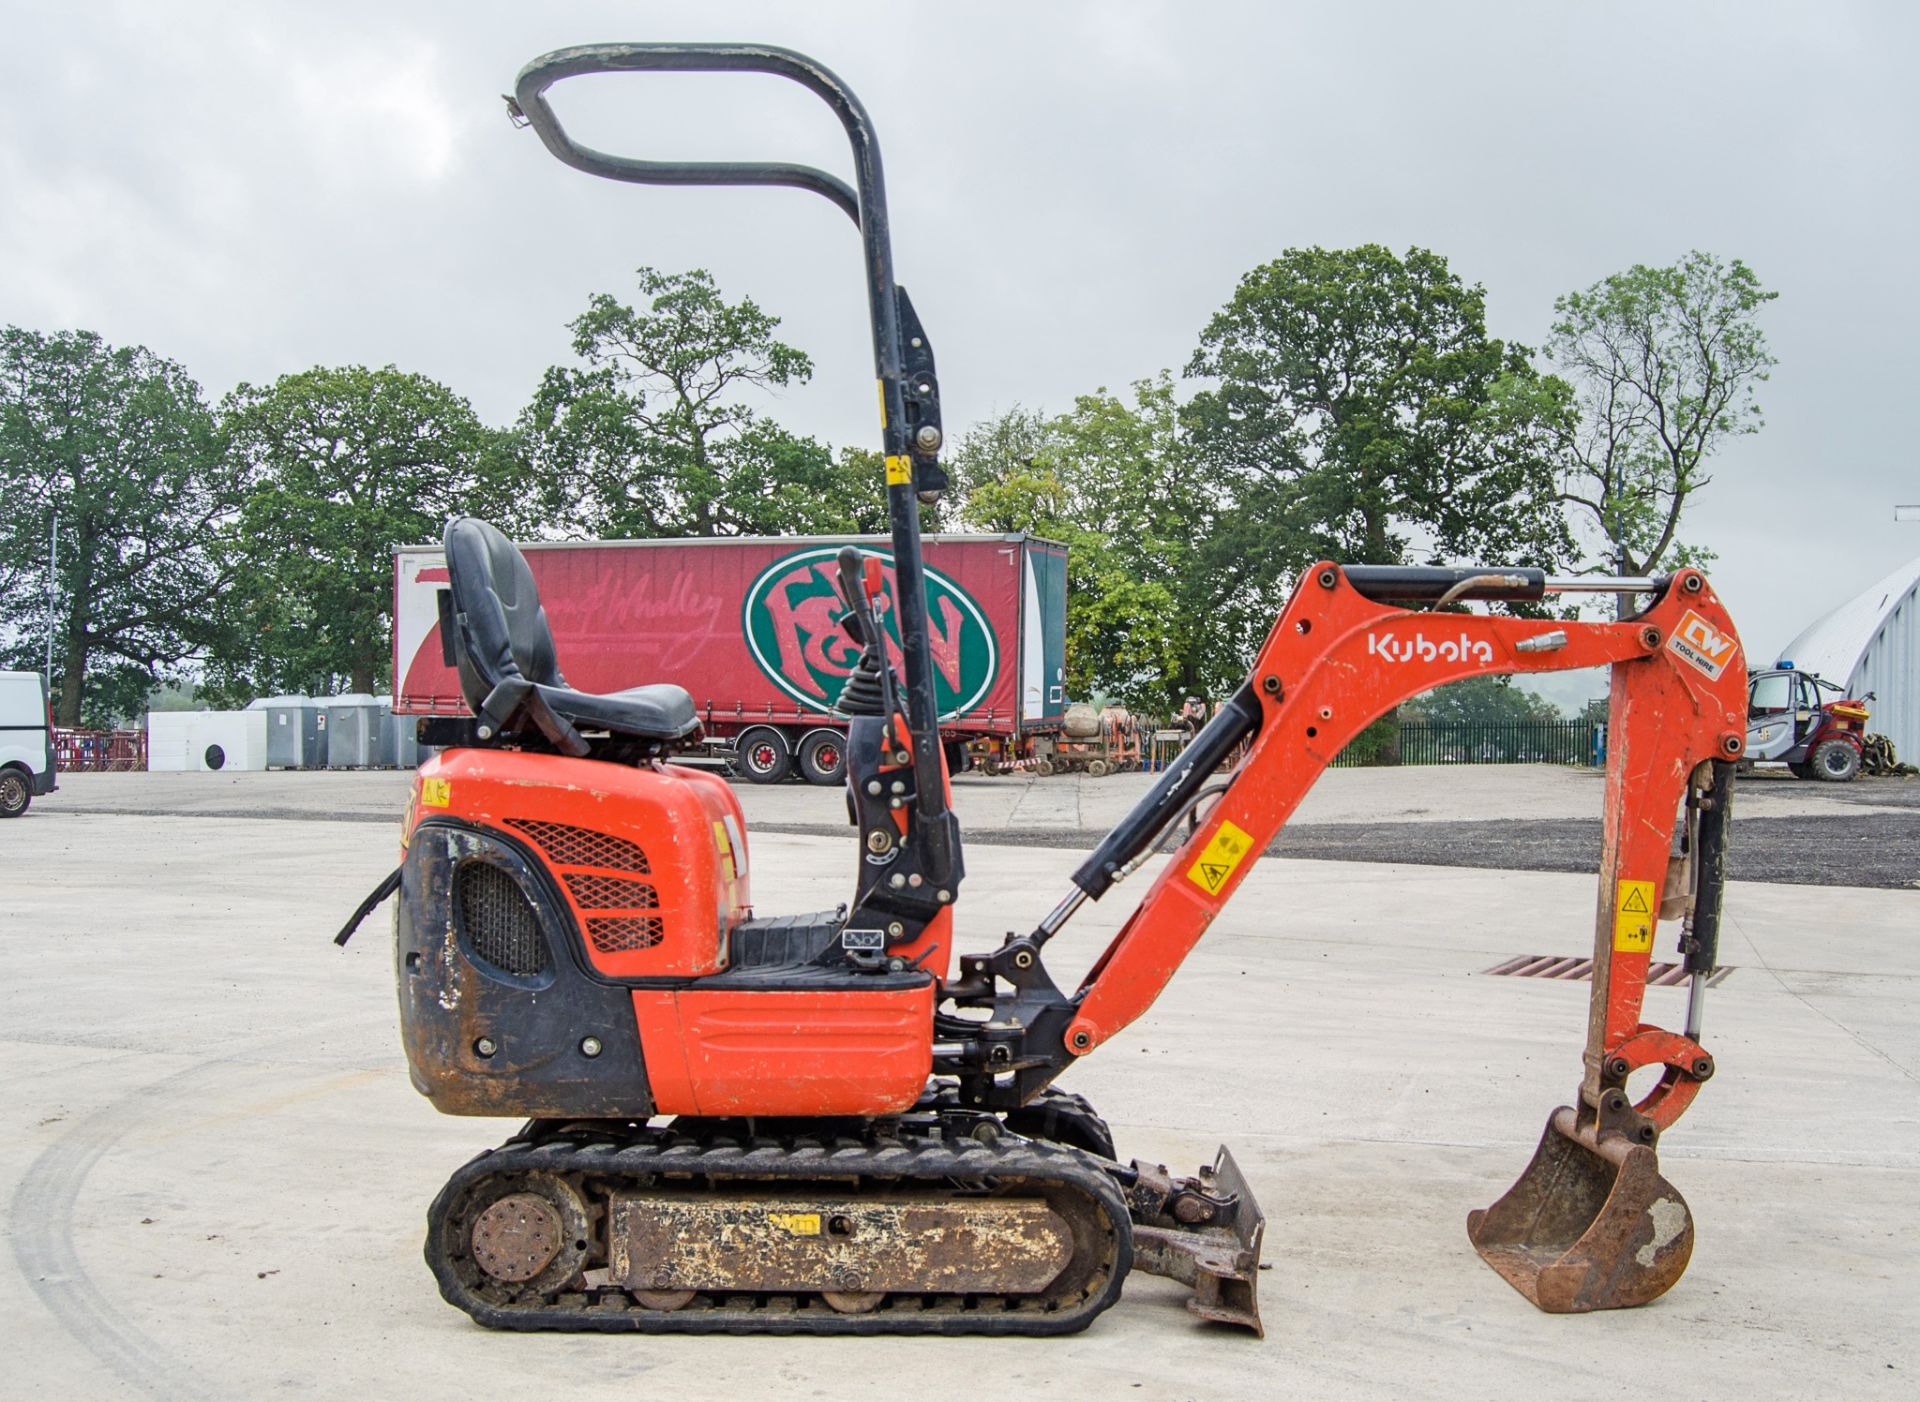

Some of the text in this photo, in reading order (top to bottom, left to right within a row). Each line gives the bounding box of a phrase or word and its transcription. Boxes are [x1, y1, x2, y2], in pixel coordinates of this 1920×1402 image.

[1368, 632, 1493, 663] Kubota
[1684, 619, 1731, 658] CW
[1674, 640, 1715, 673] TOOL HIRE
